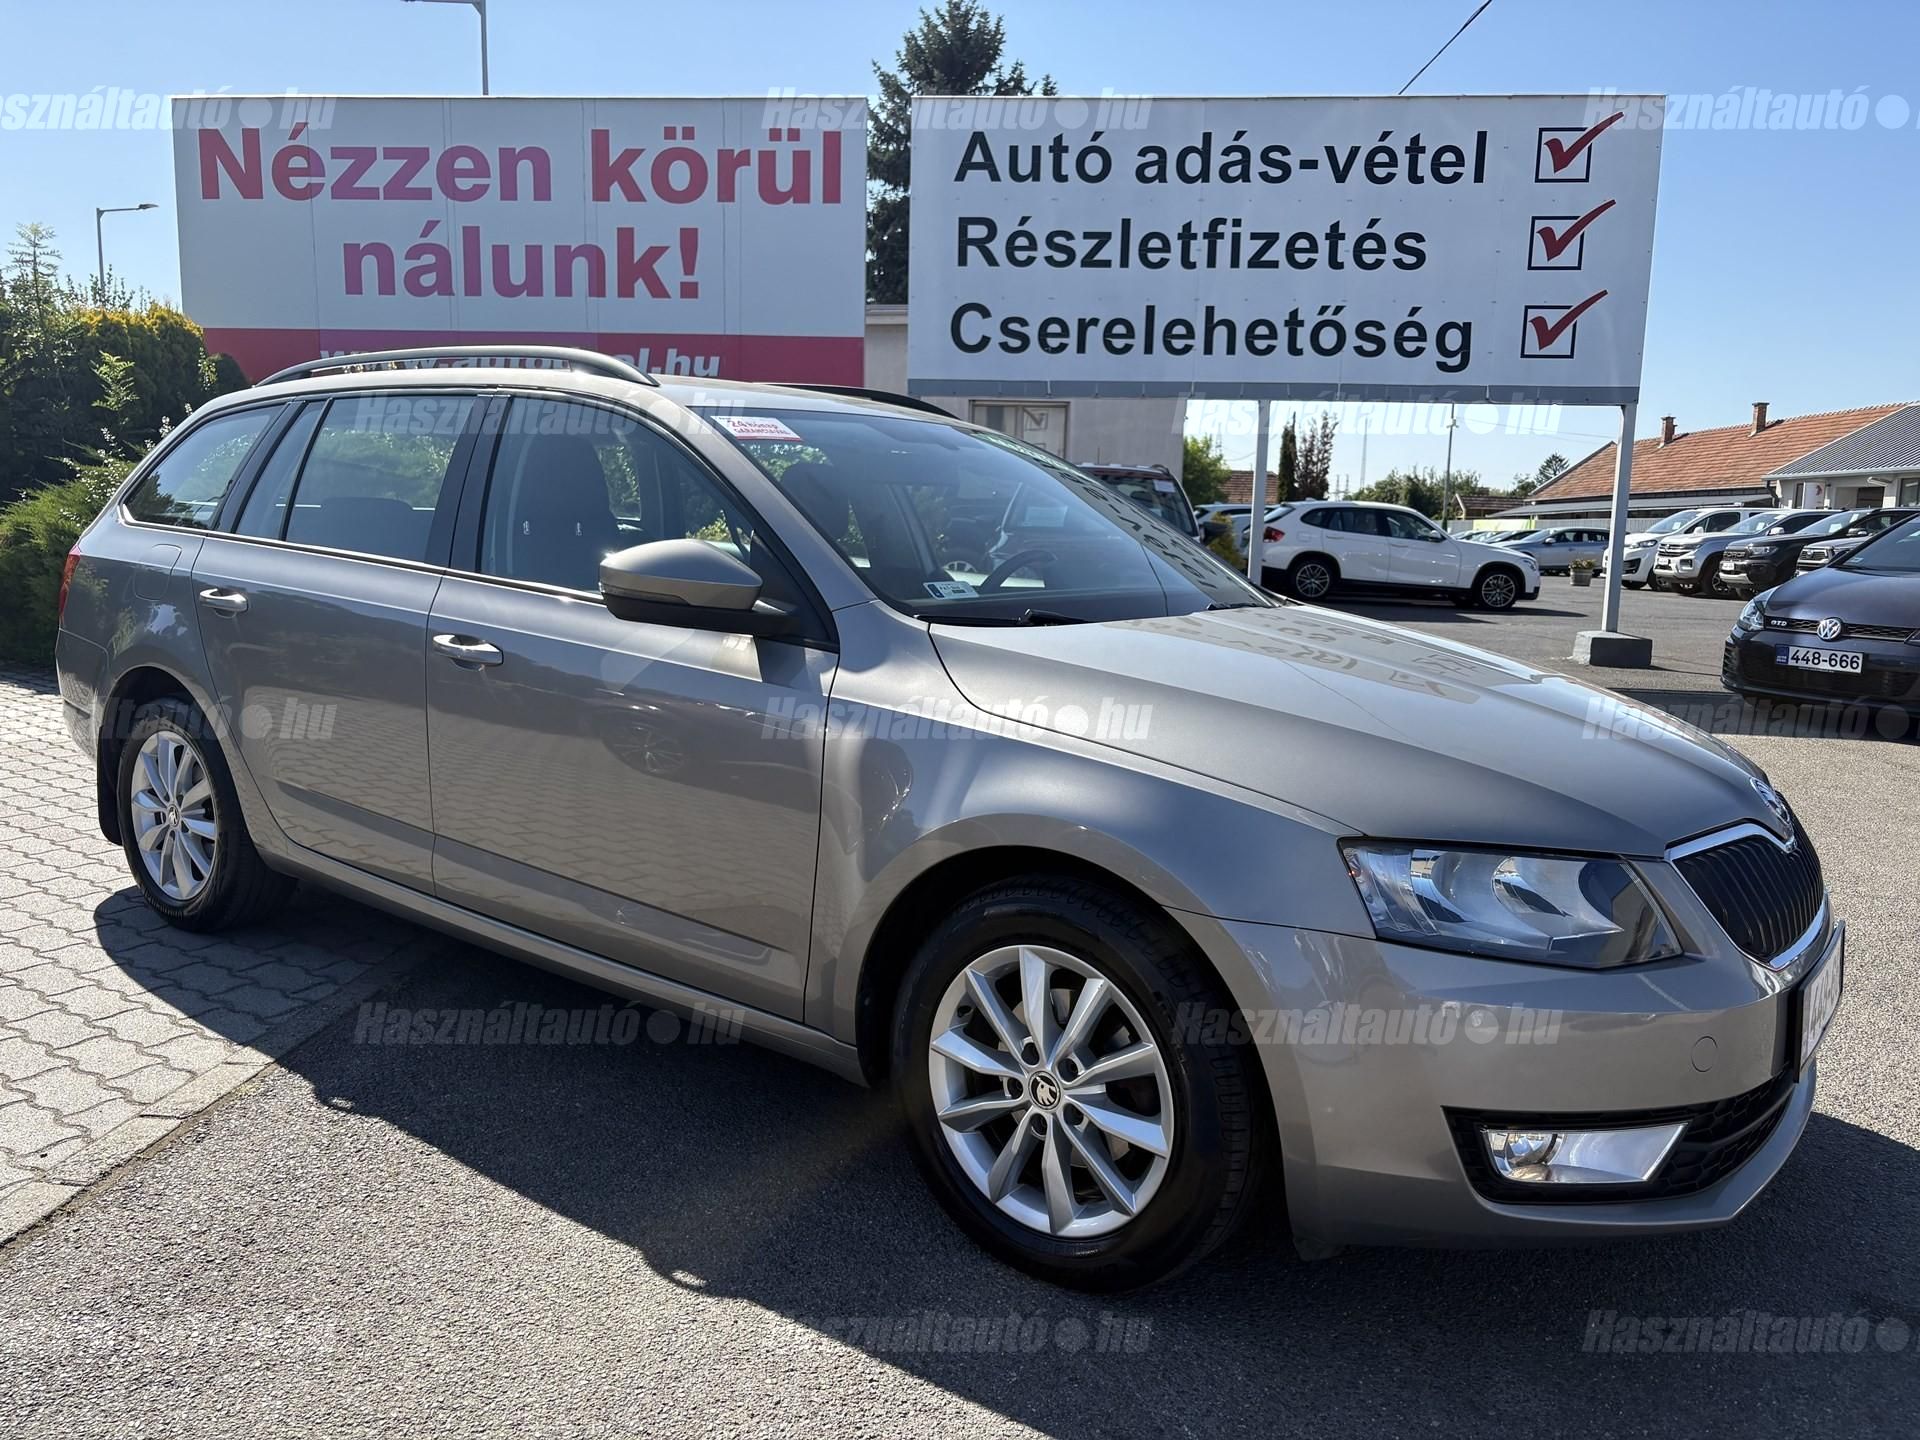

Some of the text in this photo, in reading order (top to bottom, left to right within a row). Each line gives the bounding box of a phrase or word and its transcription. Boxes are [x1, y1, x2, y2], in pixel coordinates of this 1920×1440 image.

[199, 122, 843, 204] Nézzen körül
[953, 130, 1488, 185] Autó adás-vétel
[343, 221, 701, 300] nálunk!
[957, 216, 1427, 271] Részletfizetés
[950, 304, 1472, 373] Cserelehetőség
[1790, 649, 1860, 670] 448-666
